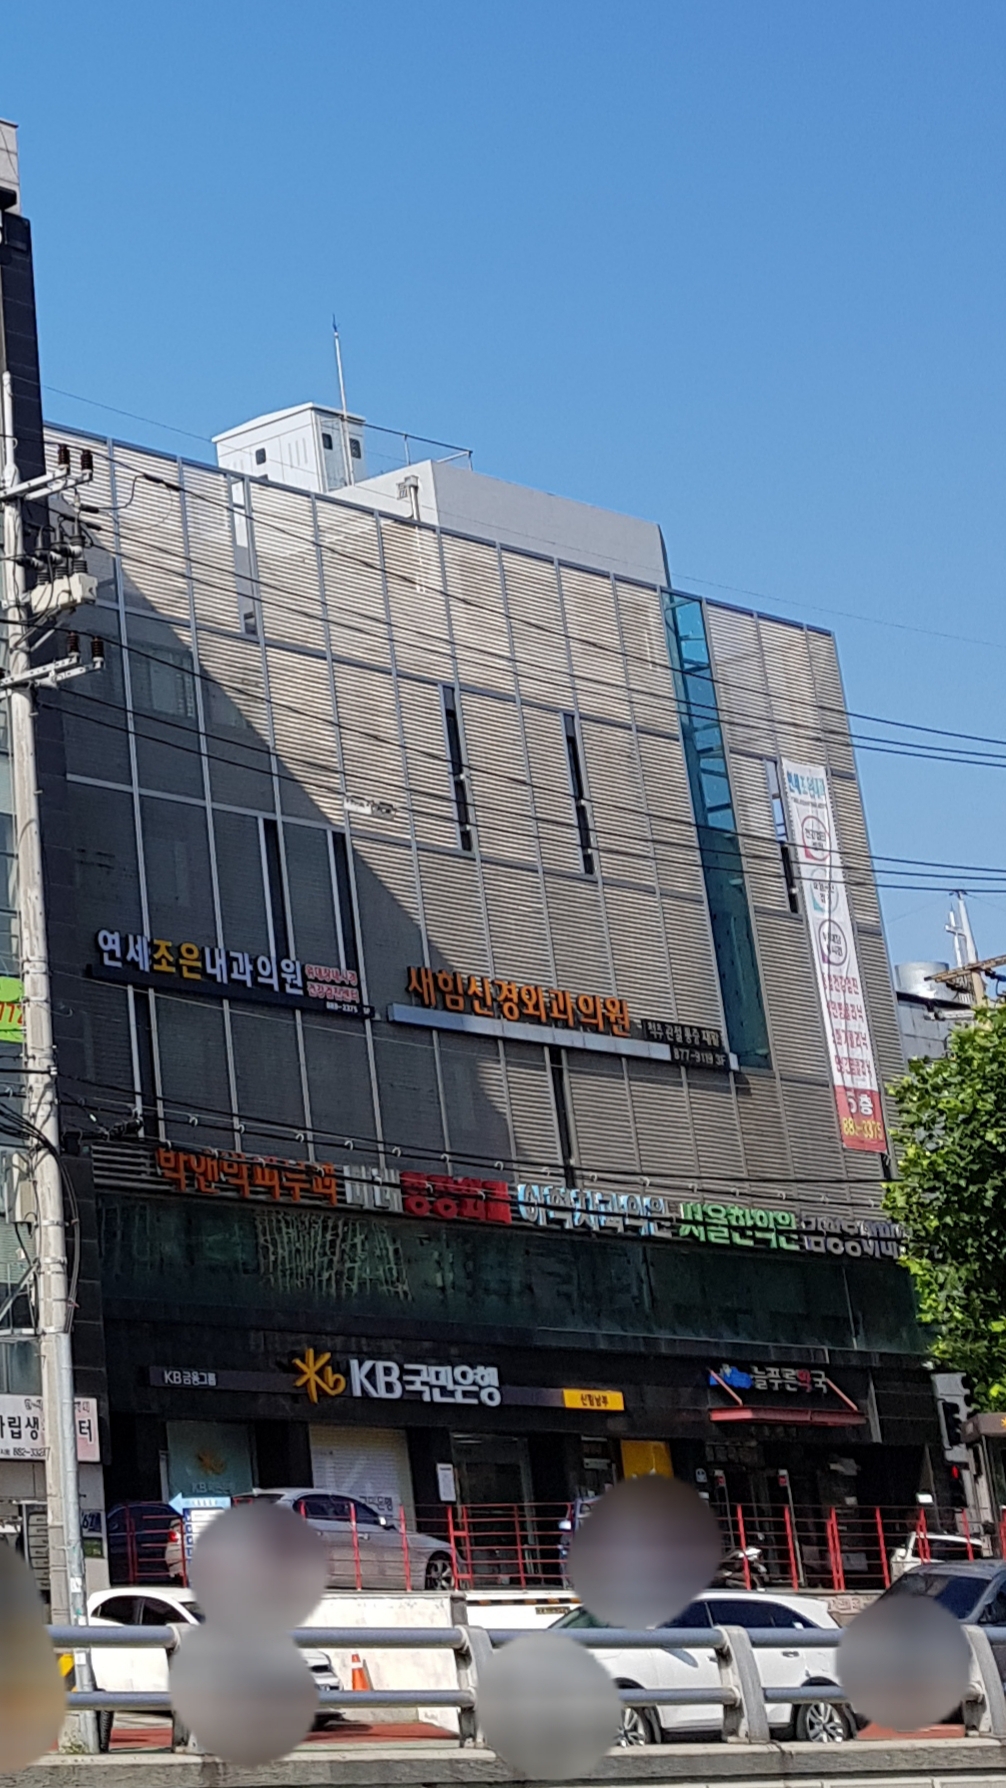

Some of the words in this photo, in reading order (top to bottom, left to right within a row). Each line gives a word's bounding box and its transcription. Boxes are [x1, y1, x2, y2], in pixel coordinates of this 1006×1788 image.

[97, 928, 305, 997] 연세조은내과의원
[406, 966, 632, 1037] 새힘신경외과의원
[350, 1359, 502, 1407] KB국민은행
